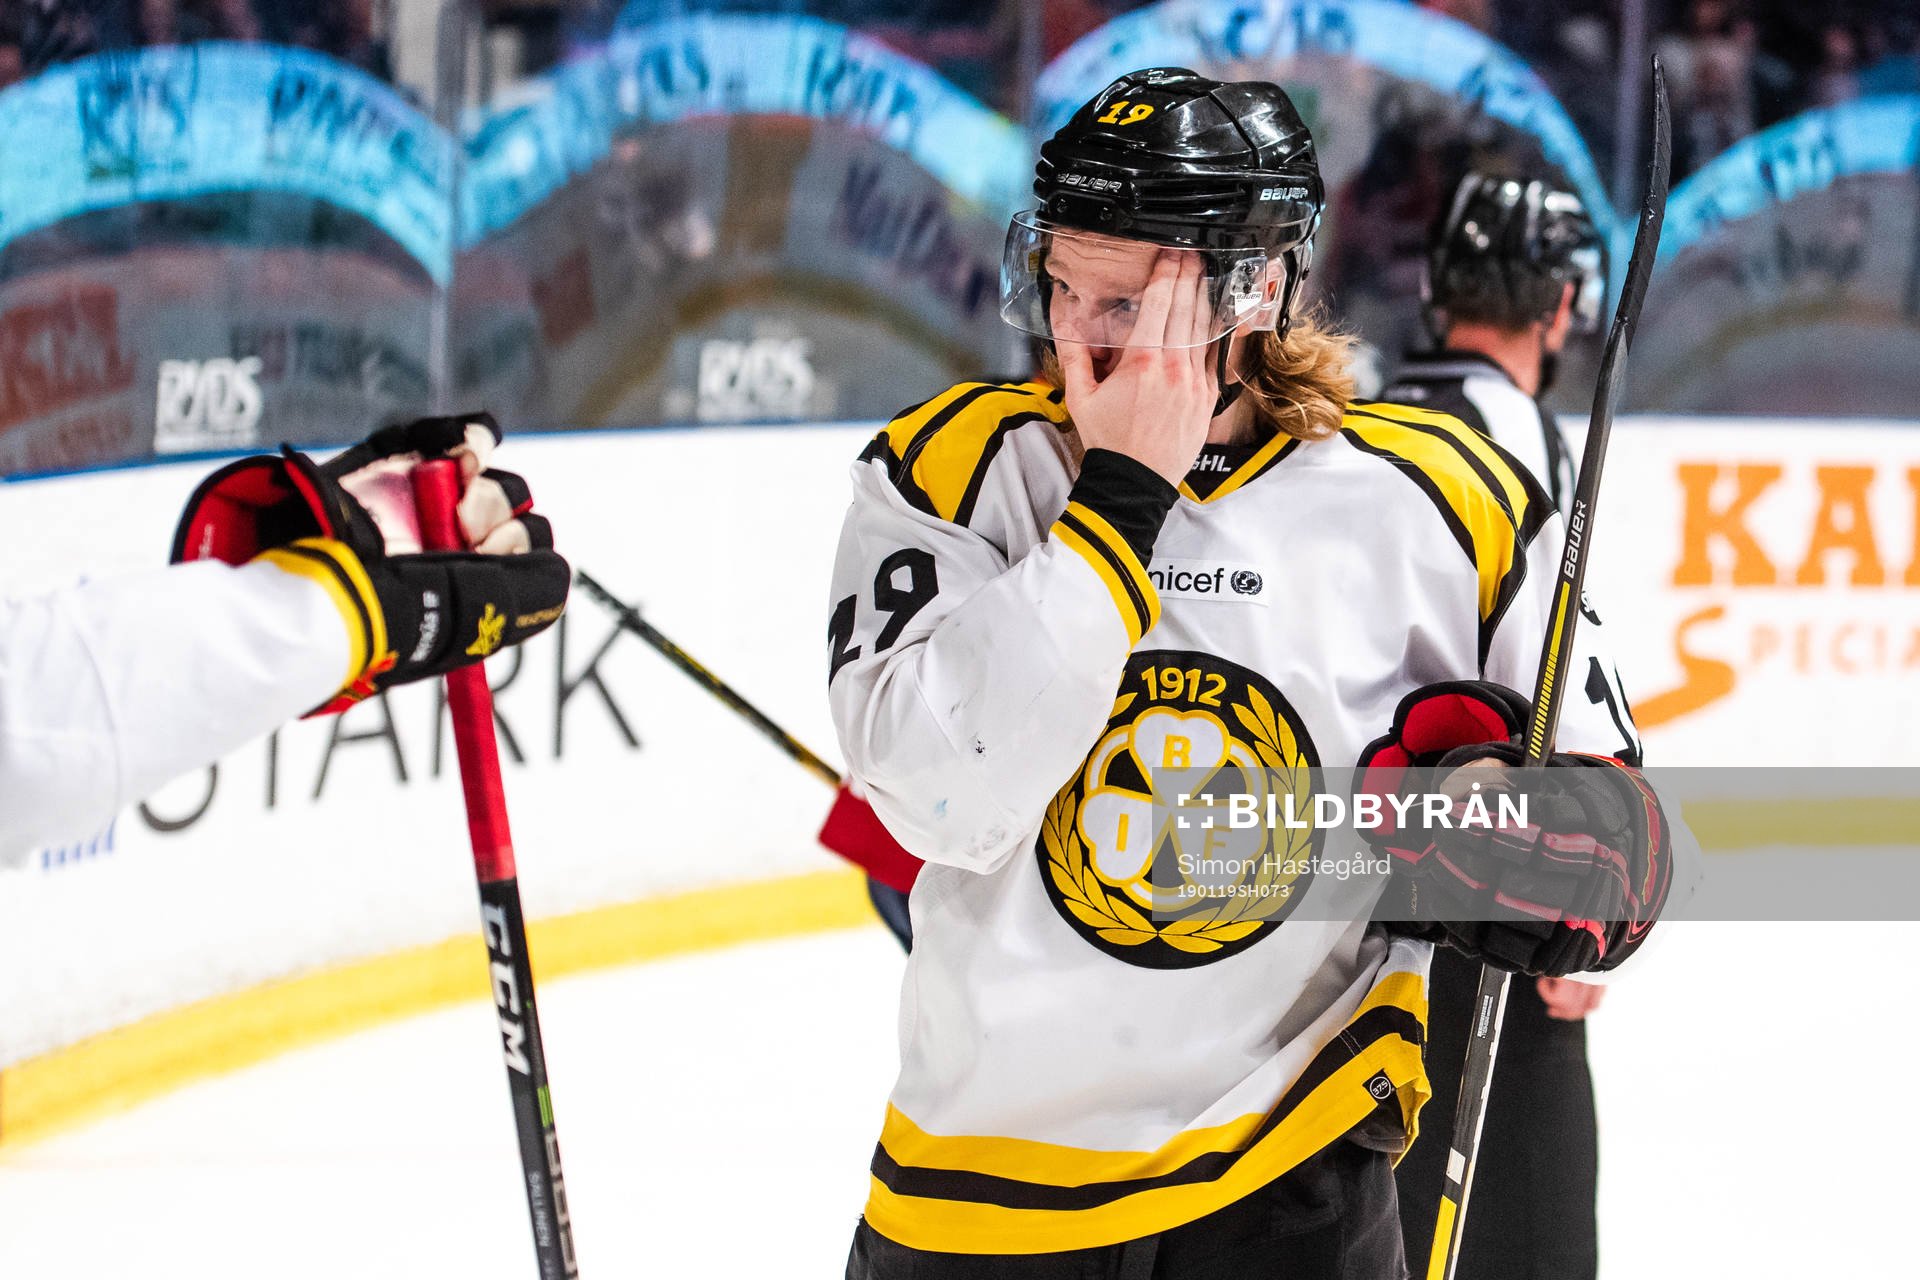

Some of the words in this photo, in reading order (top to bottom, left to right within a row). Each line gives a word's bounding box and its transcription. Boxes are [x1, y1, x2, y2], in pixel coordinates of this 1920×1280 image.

[1097, 101, 1154, 126] 19
[1671, 462, 1920, 587] KA
[1148, 565, 1225, 594] nicef
[1141, 665, 1227, 707] 1912
[1161, 734, 1192, 772] B
[1115, 813, 1129, 852] I
[482, 904, 532, 1076] CCM
